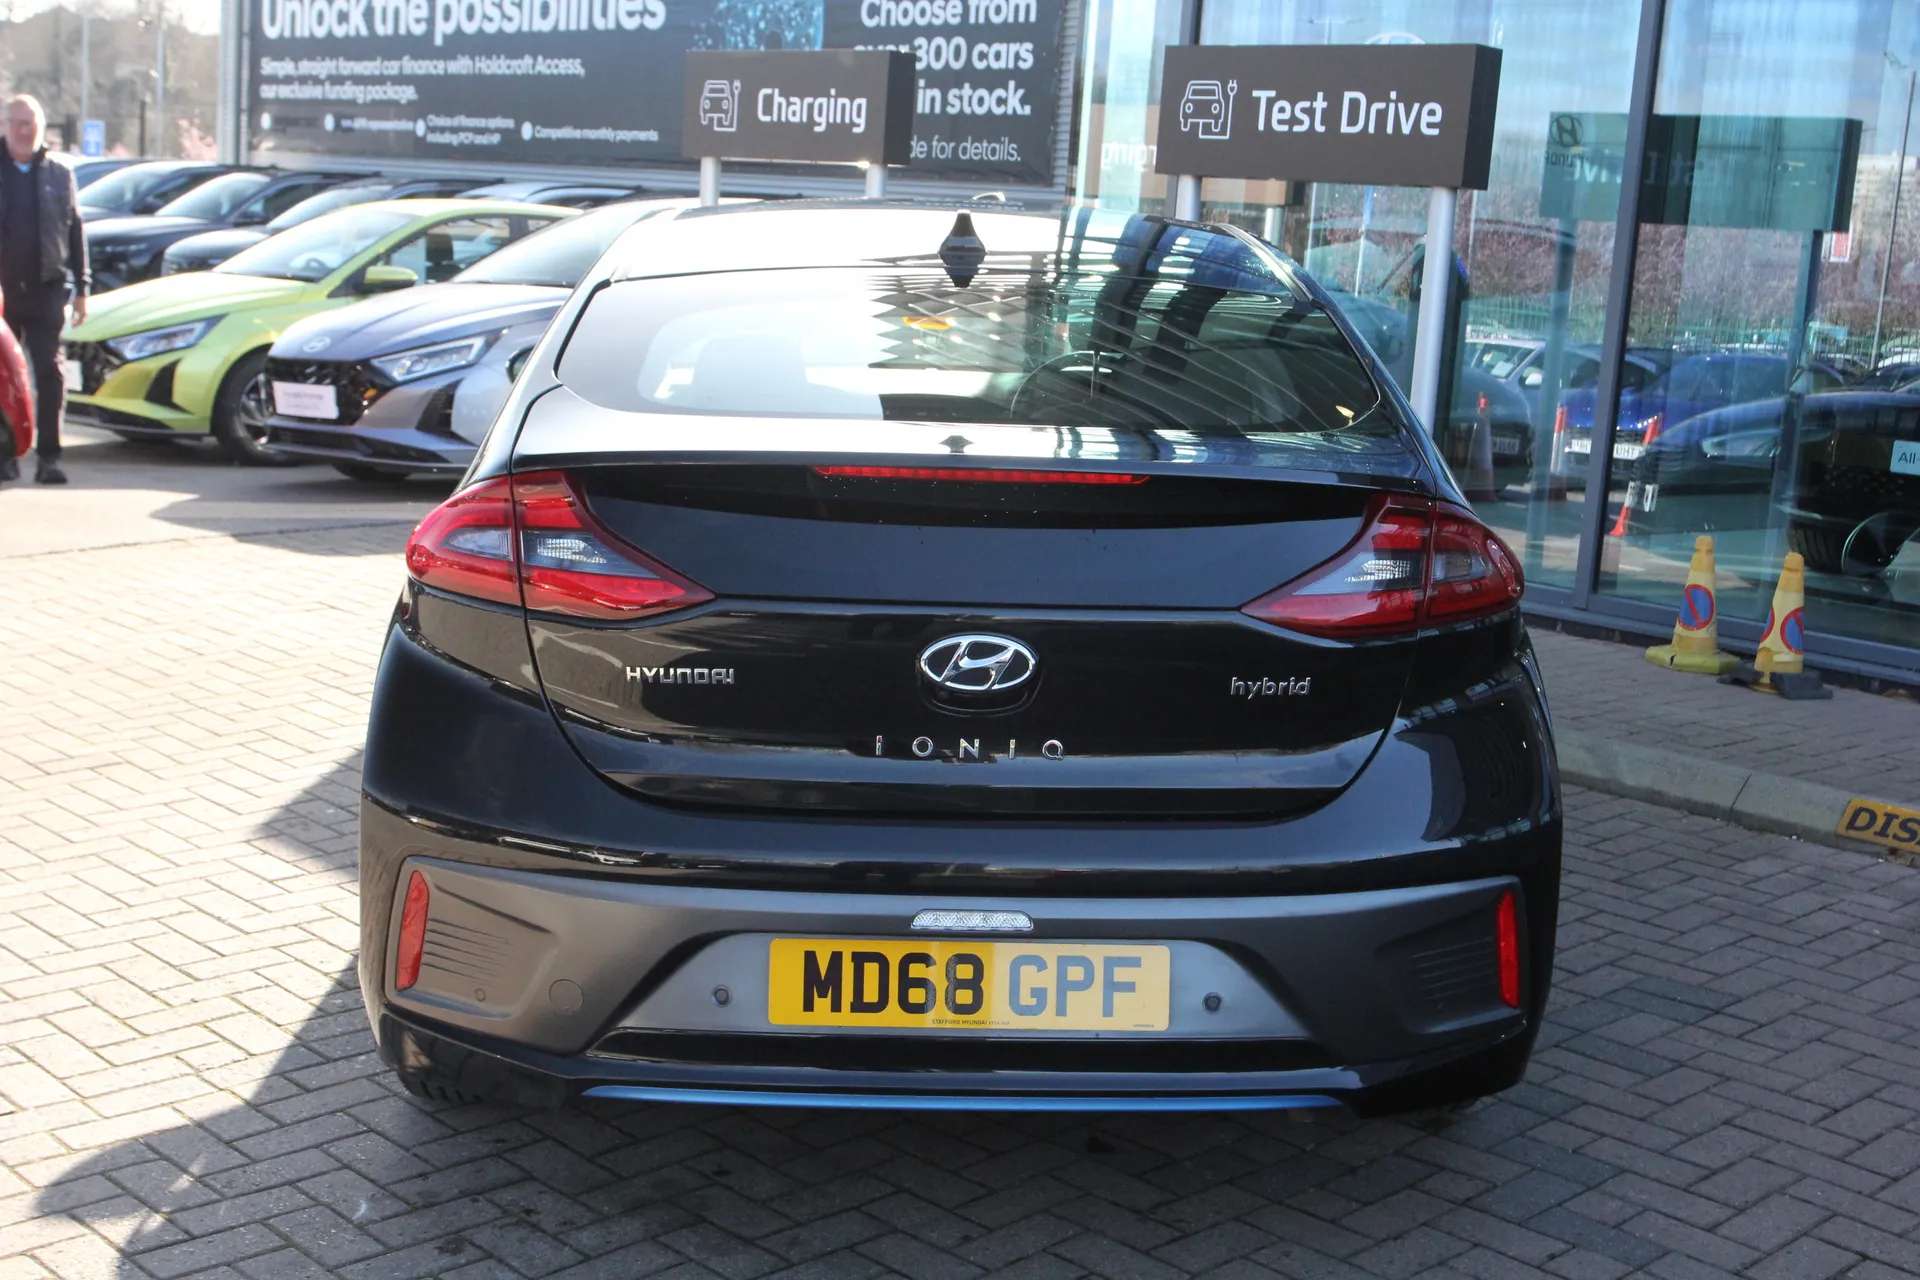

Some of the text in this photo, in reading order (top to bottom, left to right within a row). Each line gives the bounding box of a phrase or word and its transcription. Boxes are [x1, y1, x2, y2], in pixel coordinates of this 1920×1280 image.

[262, 0, 667, 46] Unlock the possibilities
[861, 0, 1037, 27] Choose from
[447, 54, 473, 75] with
[474, 54, 533, 75] Holdcroft
[534, 55, 586, 78] Access,
[914, 36, 1034, 70] 300 cars
[324, 80, 364, 104] funding
[917, 79, 1032, 115] in stock.
[757, 88, 867, 133] Charging
[1252, 90, 1443, 136] Test Drive
[932, 135, 955, 160] for
[959, 136, 1021, 162] details.
[625, 666, 735, 685] HYUNDAI
[1230, 675, 1312, 699] hybrid
[875, 735, 1066, 761] IONIQ
[1845, 805, 1920, 845] DIS
[802, 949, 1142, 1019] MD68 GPF
